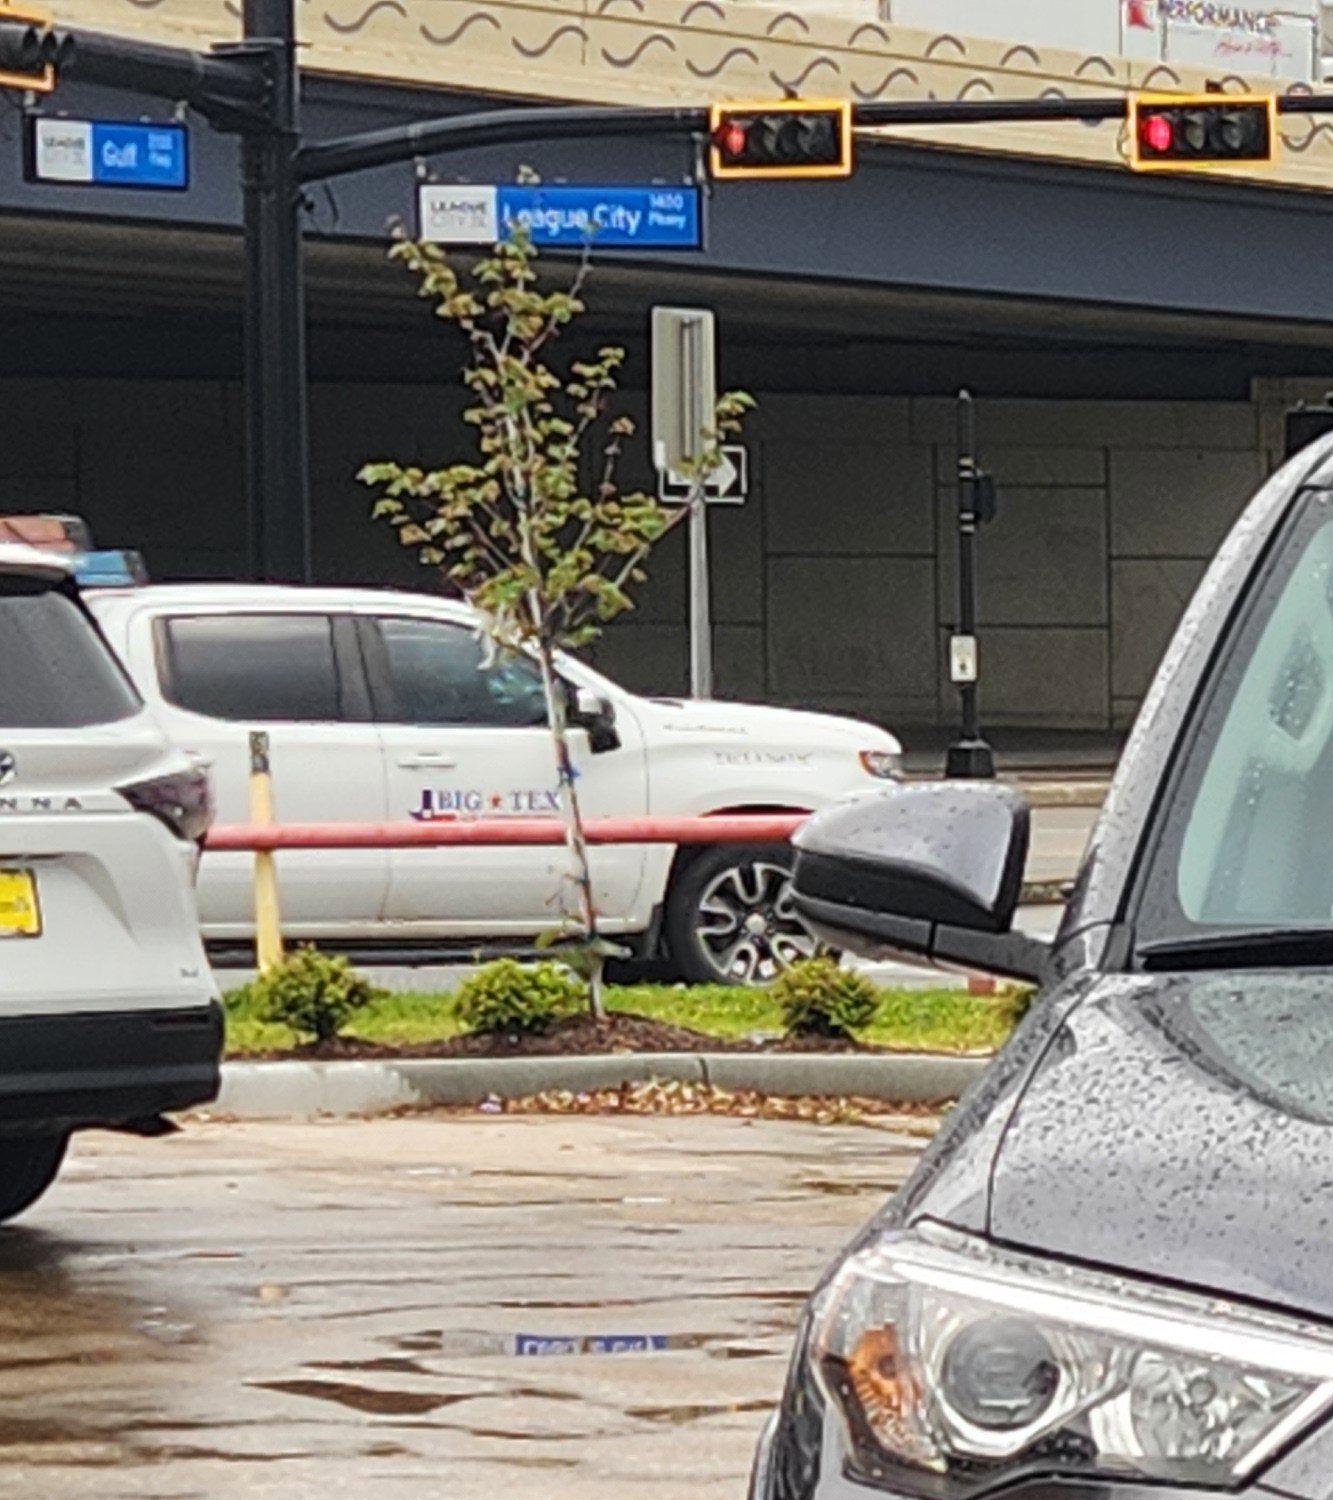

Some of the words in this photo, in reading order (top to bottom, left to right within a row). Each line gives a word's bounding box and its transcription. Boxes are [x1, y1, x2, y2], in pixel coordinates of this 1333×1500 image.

[503, 203, 588, 237] League
[593, 203, 642, 236] City
[437, 789, 482, 811] BIG
[509, 789, 561, 811] TEX
